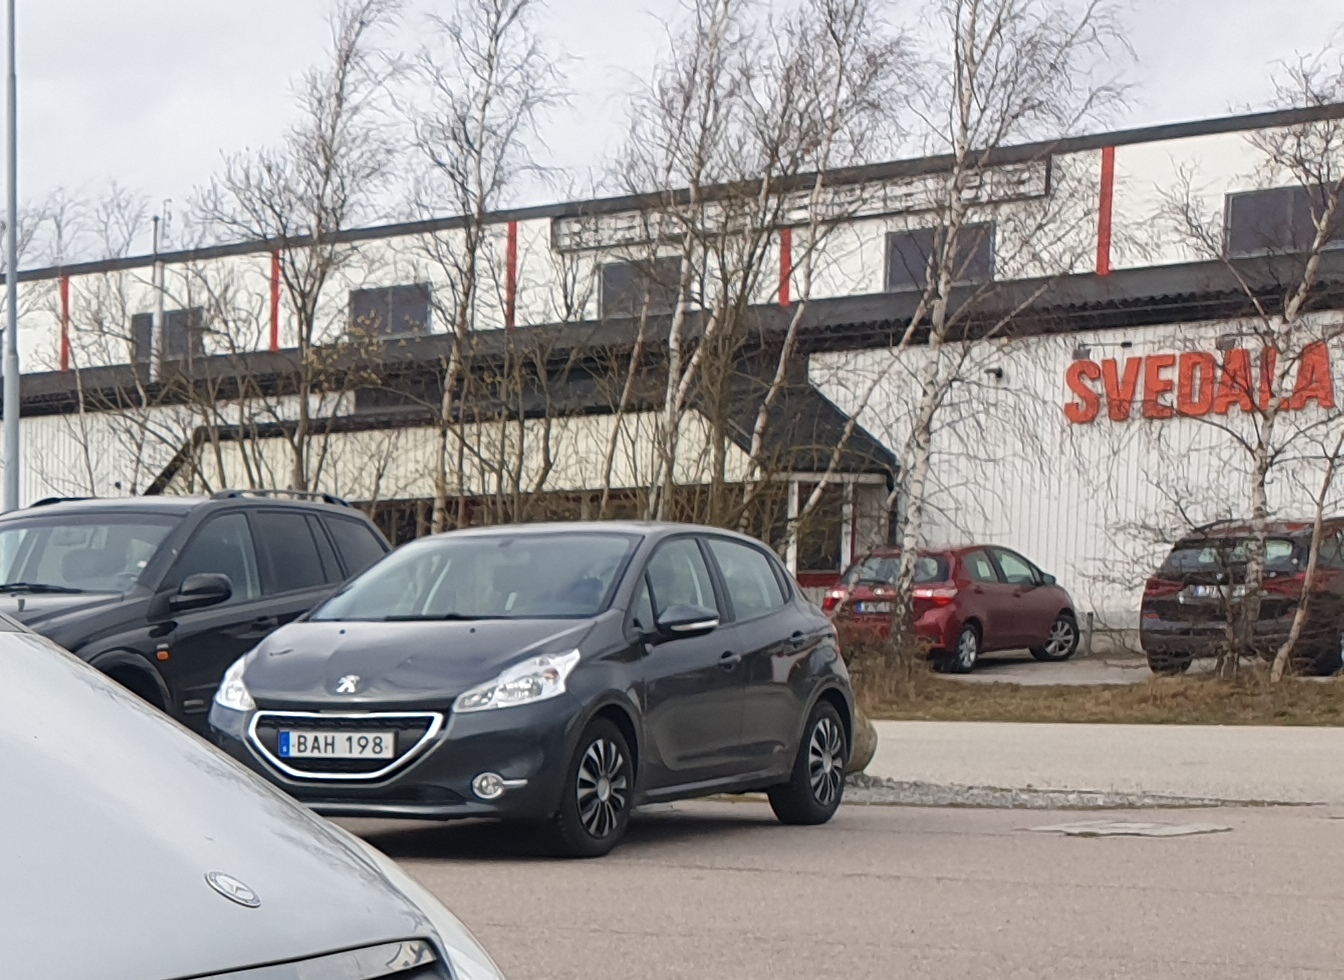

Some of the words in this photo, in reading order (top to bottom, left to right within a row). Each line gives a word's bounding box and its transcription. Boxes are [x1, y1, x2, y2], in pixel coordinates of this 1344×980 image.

[1063, 340, 1334, 423] SVEDALA
[297, 735, 335, 754] BAH
[345, 735, 383, 755] 198
